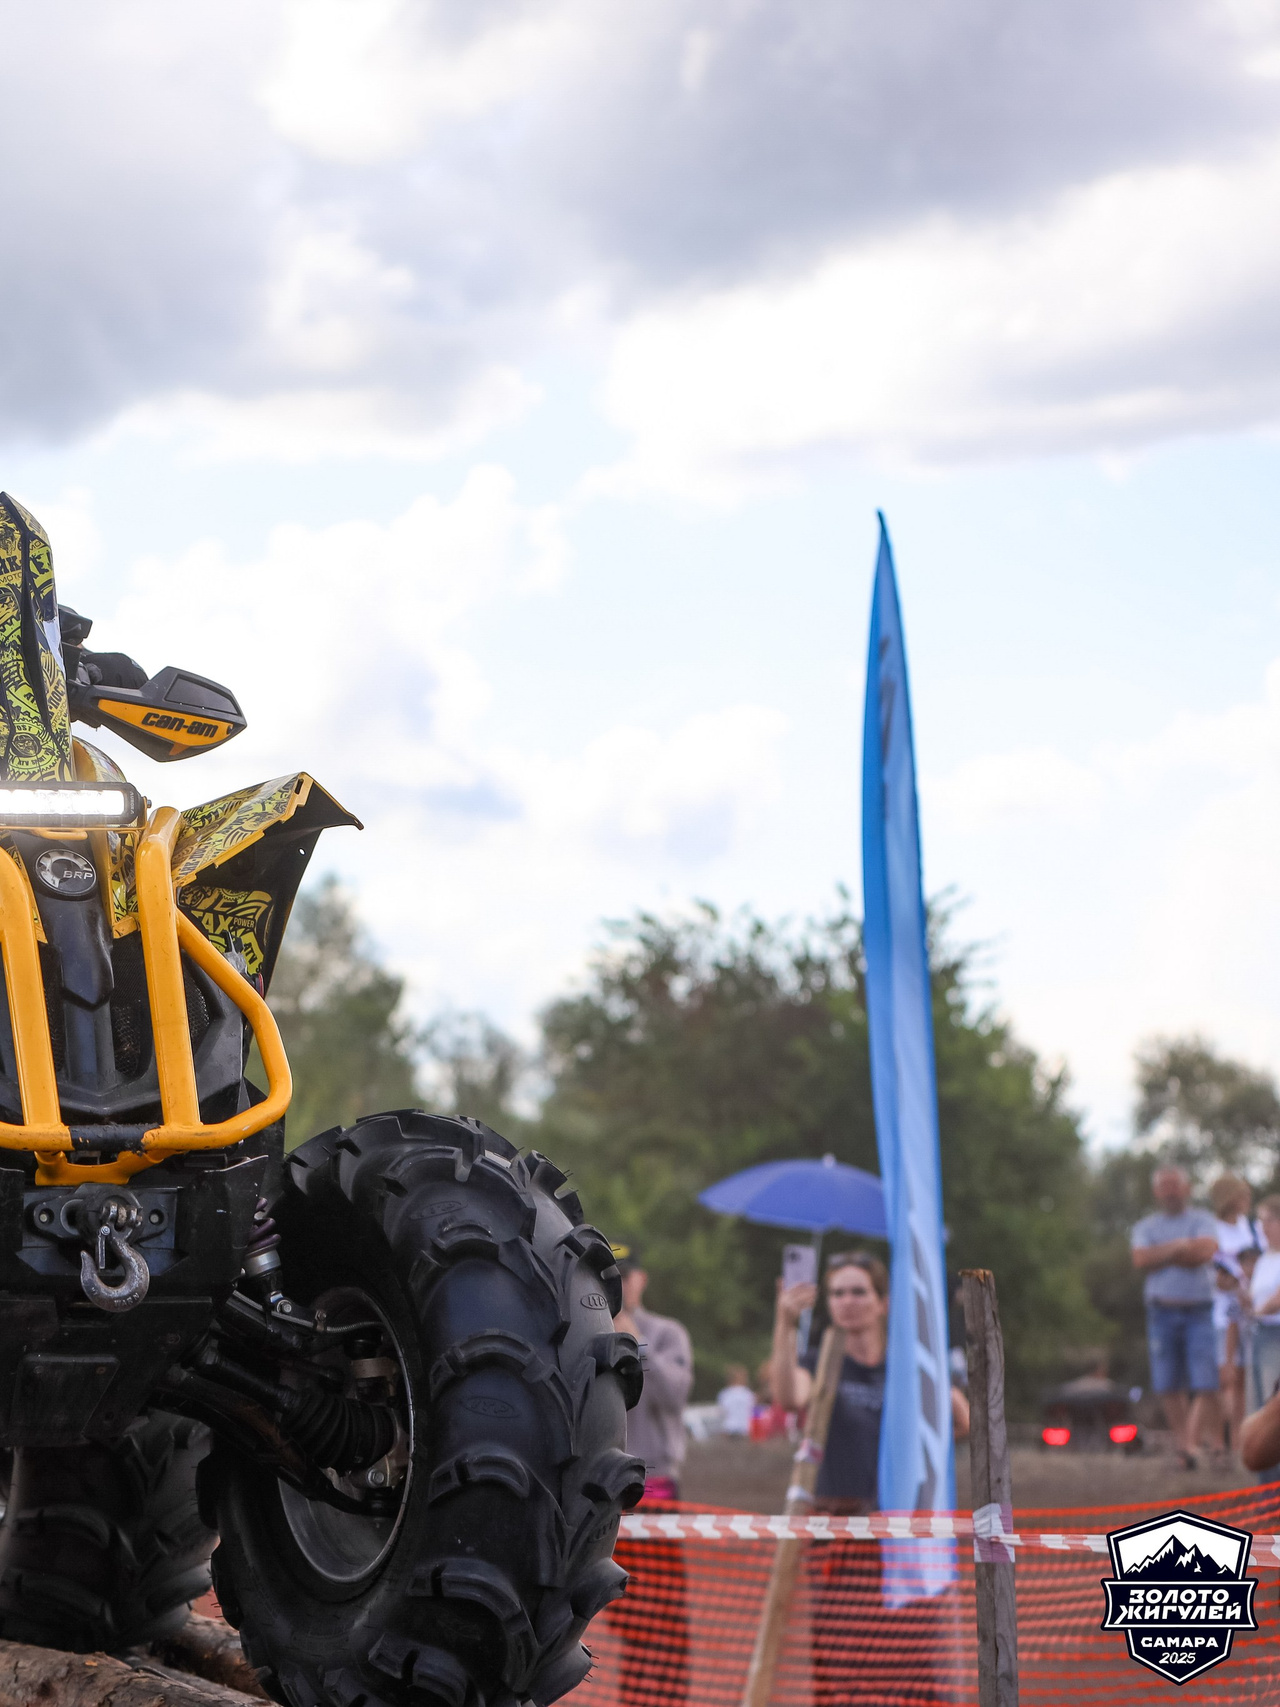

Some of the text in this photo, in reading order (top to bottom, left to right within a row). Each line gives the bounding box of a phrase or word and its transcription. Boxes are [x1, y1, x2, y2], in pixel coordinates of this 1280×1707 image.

[141, 711, 219, 739] can-am
[63, 870, 93, 880] BRP
[233, 917, 254, 928] POWER
